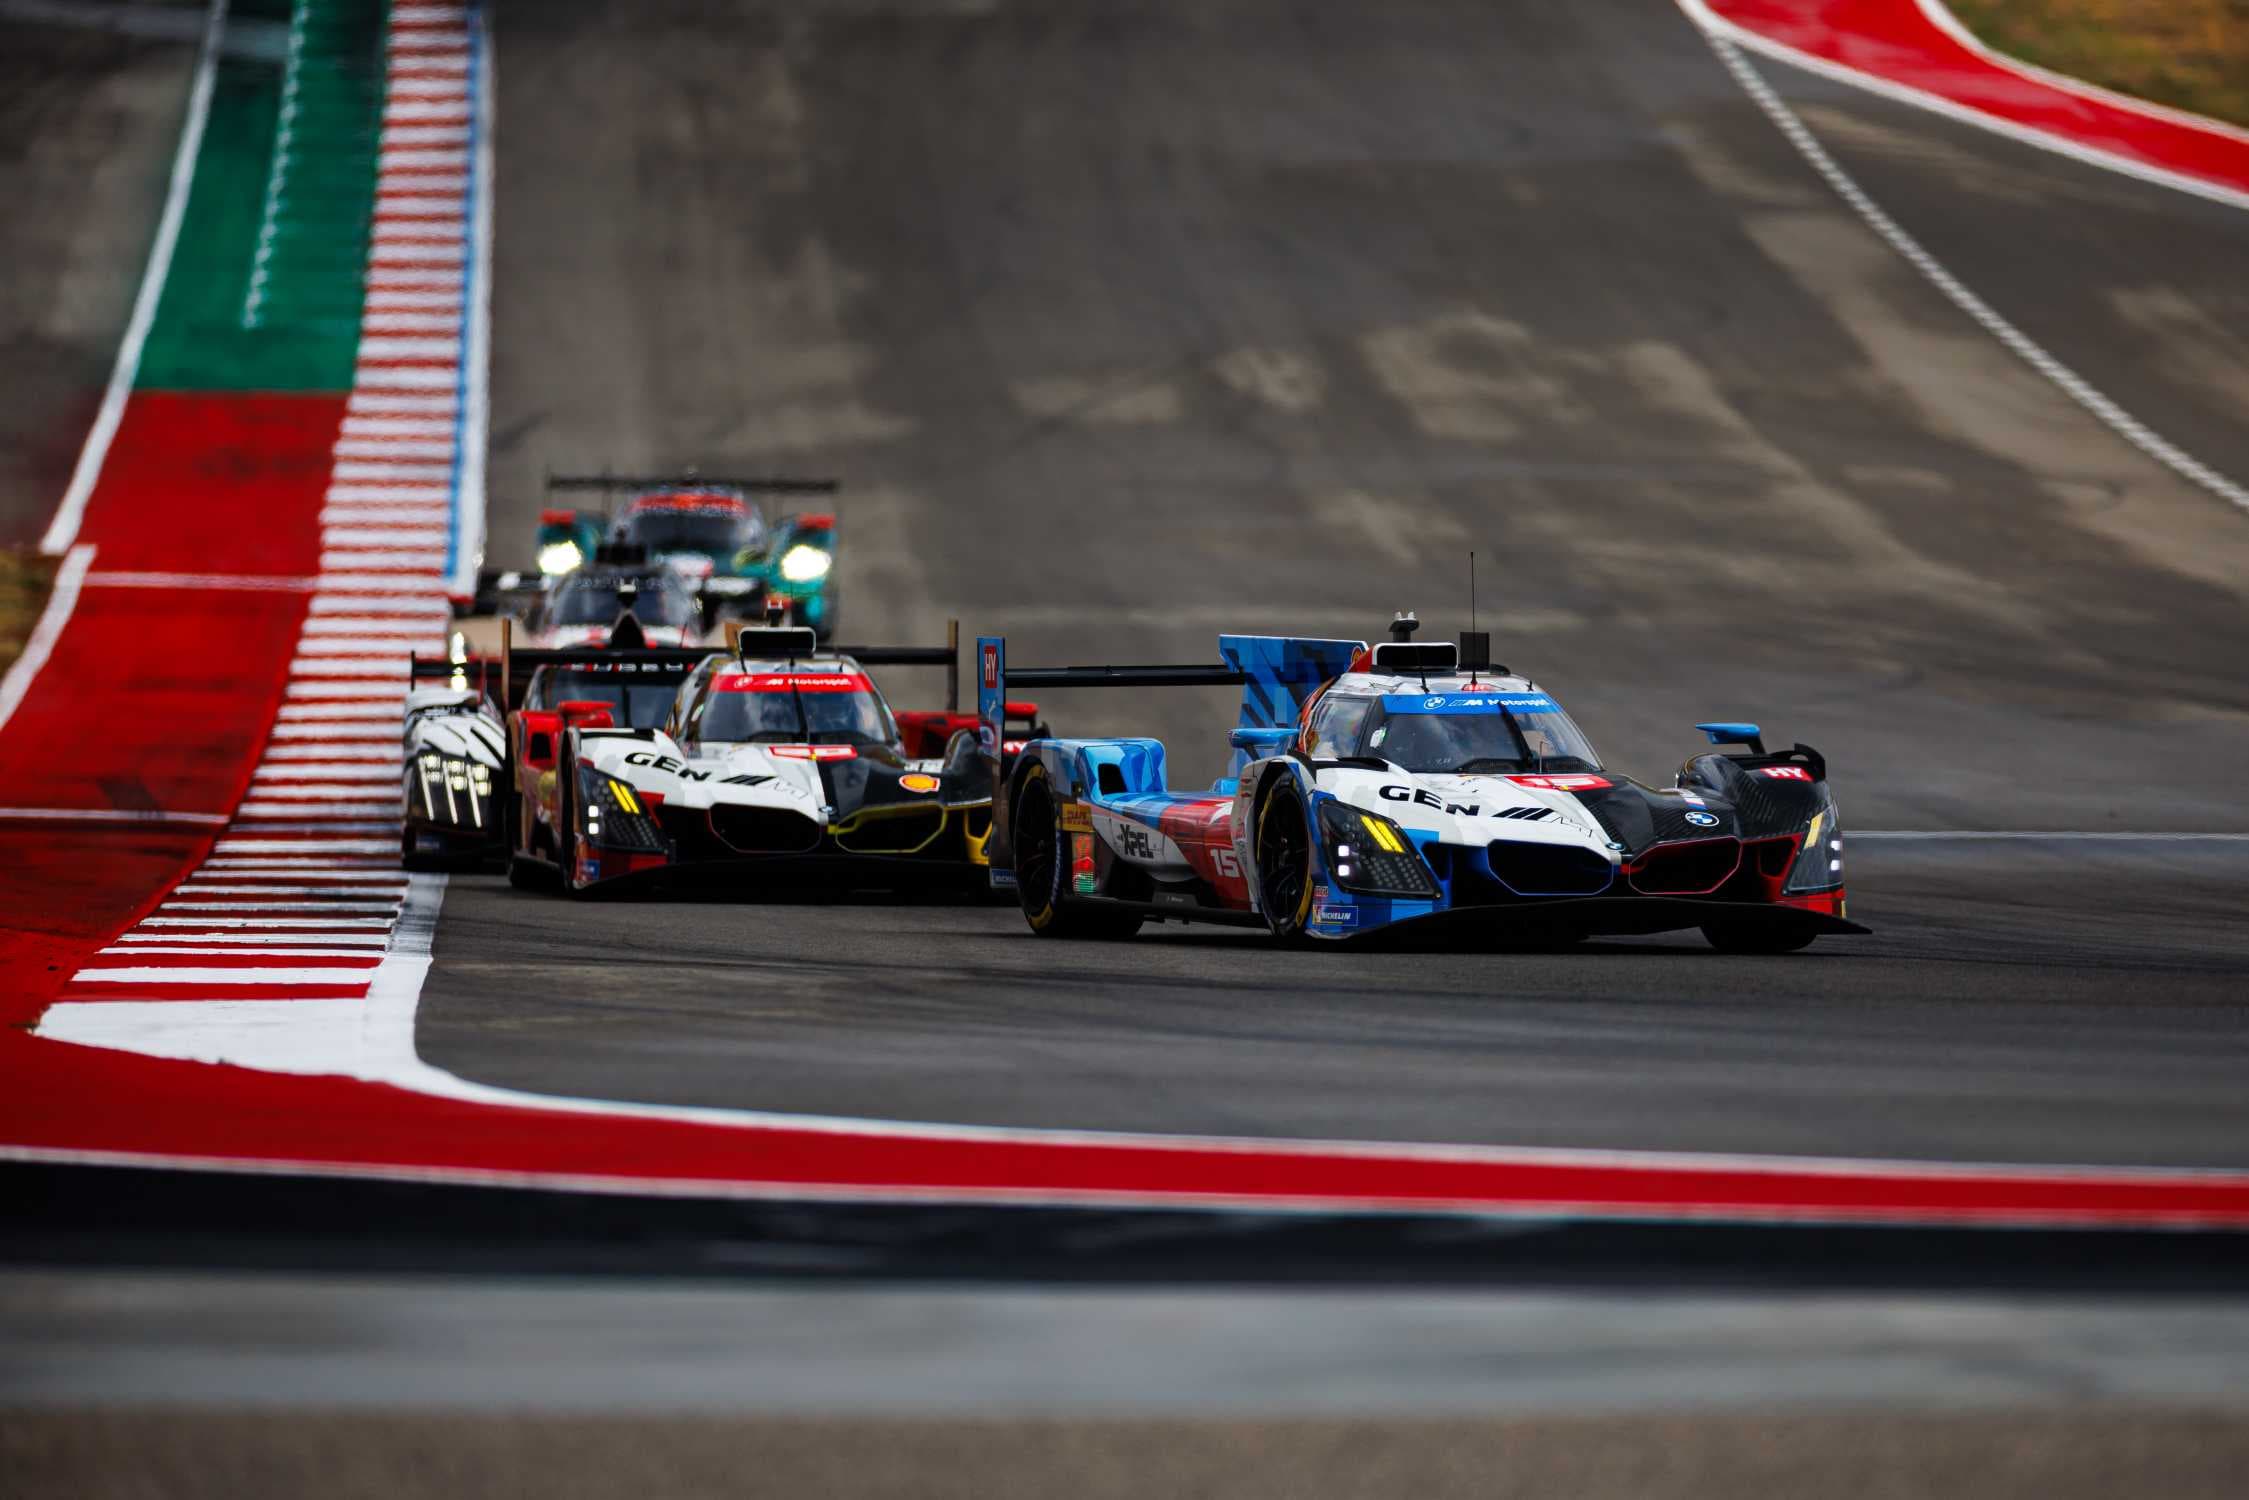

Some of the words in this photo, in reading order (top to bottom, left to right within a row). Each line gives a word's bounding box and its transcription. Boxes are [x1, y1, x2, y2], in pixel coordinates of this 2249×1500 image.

[985, 653, 997, 681] HY
[1487, 698, 1551, 708] Motorsport
[624, 752, 712, 783] GEN
[1764, 767, 1805, 780] HY
[1379, 785, 1480, 817] GEN
[1117, 823, 1154, 859] XPEL
[1210, 848, 1241, 878] 15
